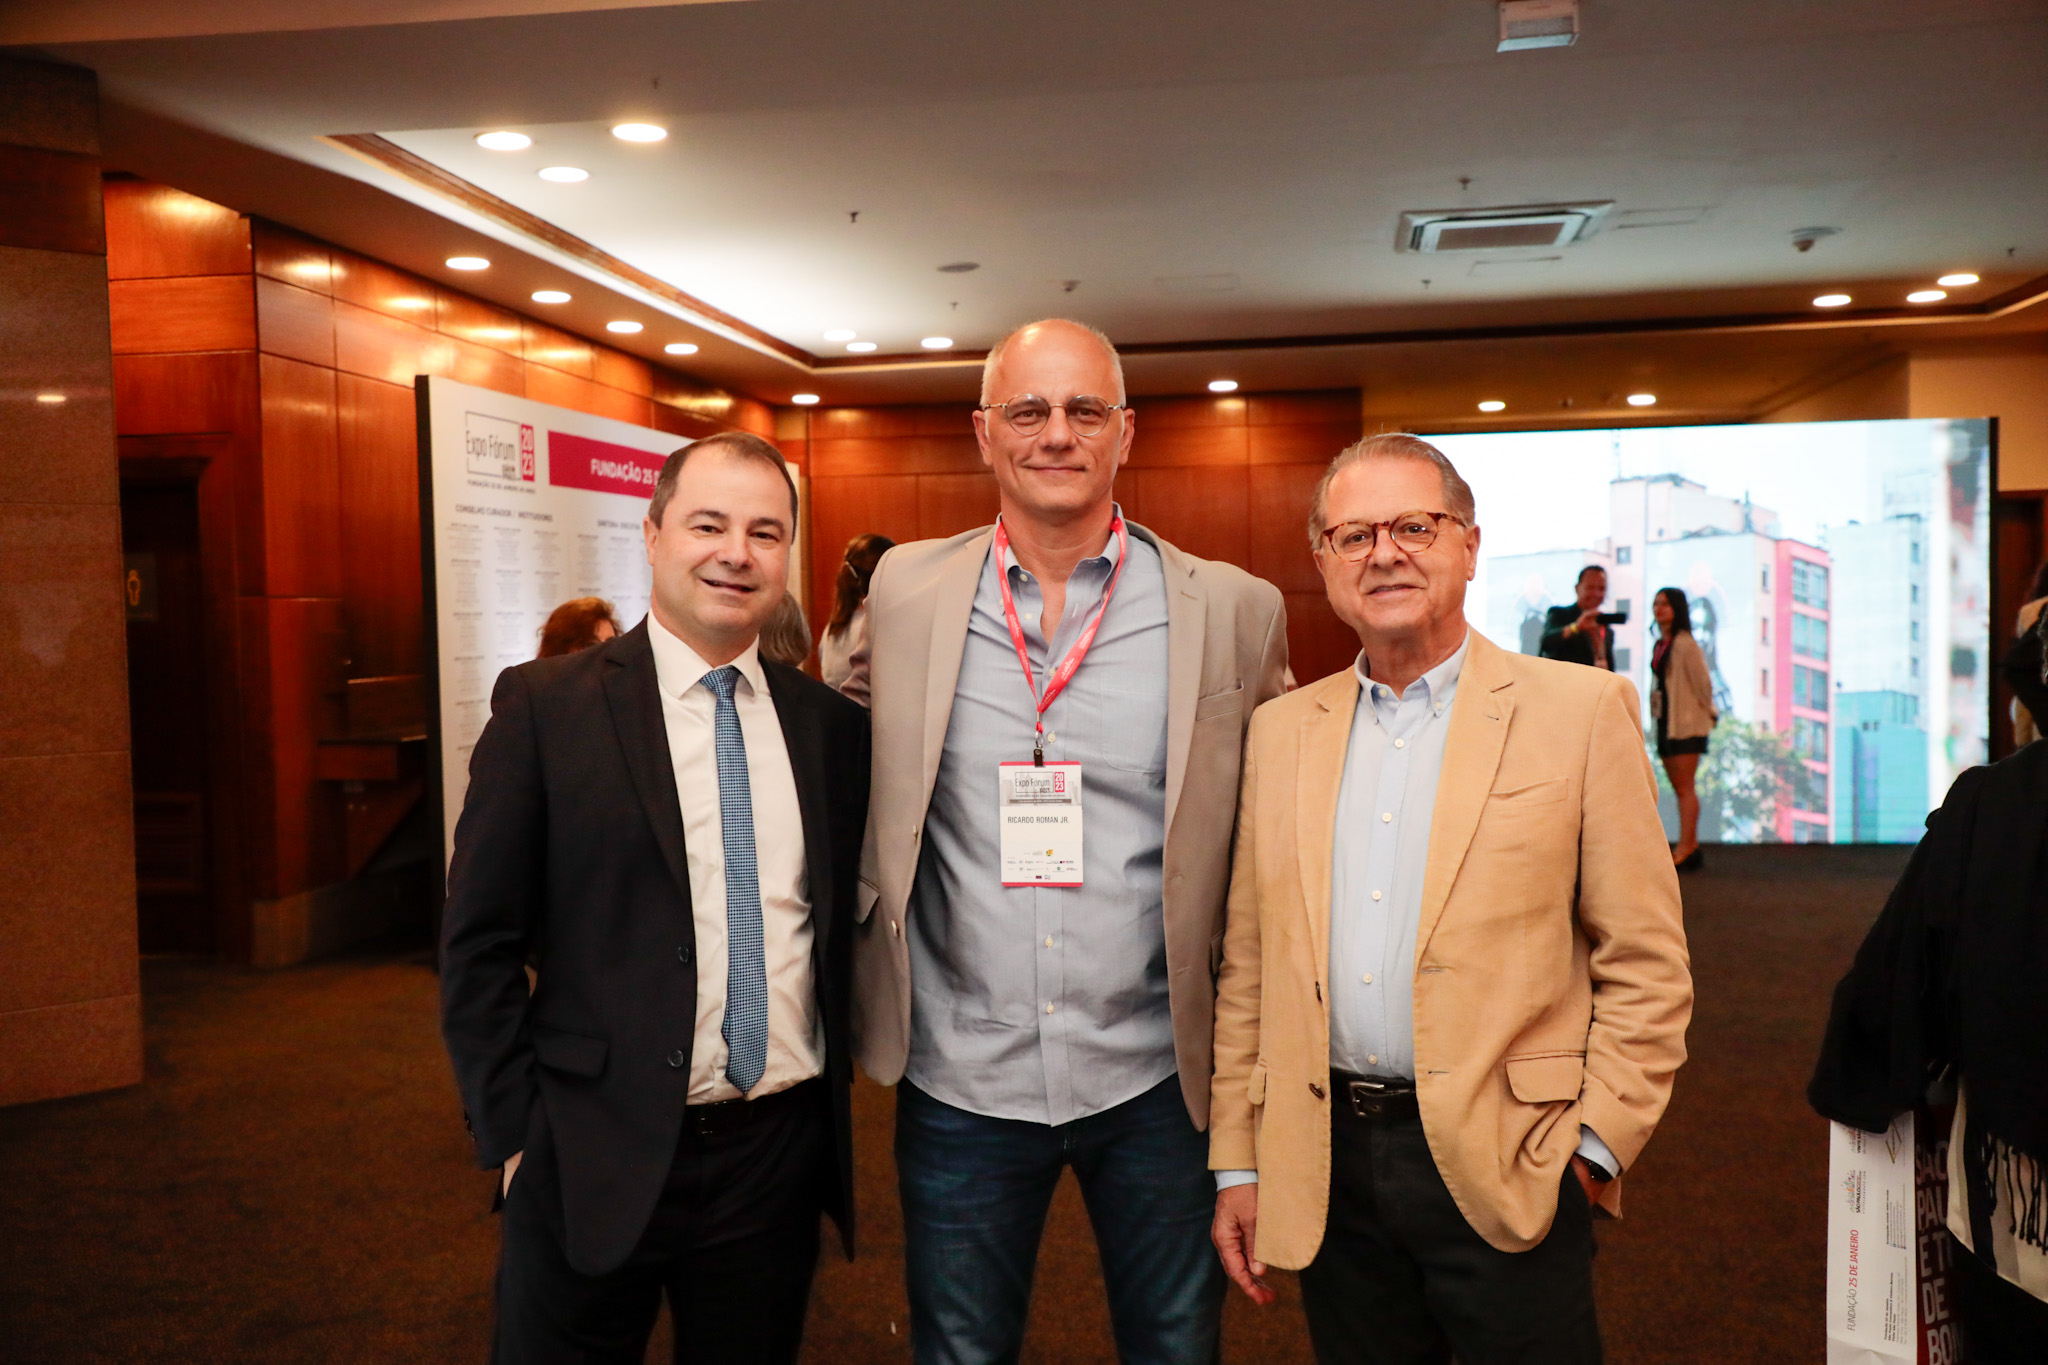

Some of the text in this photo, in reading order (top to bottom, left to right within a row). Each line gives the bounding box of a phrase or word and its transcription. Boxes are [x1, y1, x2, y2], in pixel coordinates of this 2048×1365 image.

[466, 430, 516, 461] Expo Fórum
[521, 427, 534, 451] 20
[522, 452, 534, 477] 23
[590, 458, 642, 483] FUNDAÇÃO
[642, 467, 653, 485] 25
[1015, 777, 1051, 789] Expo Fórum
[1055, 773, 1064, 781] 20
[1055, 782, 1064, 791] 23
[1007, 816, 1070, 824] RICARDO ROMAN JR.
[1847, 1229, 1859, 1332] FUNDAÇÃO 25 DE JANEIRO
[1922, 1278, 1950, 1325] DE
